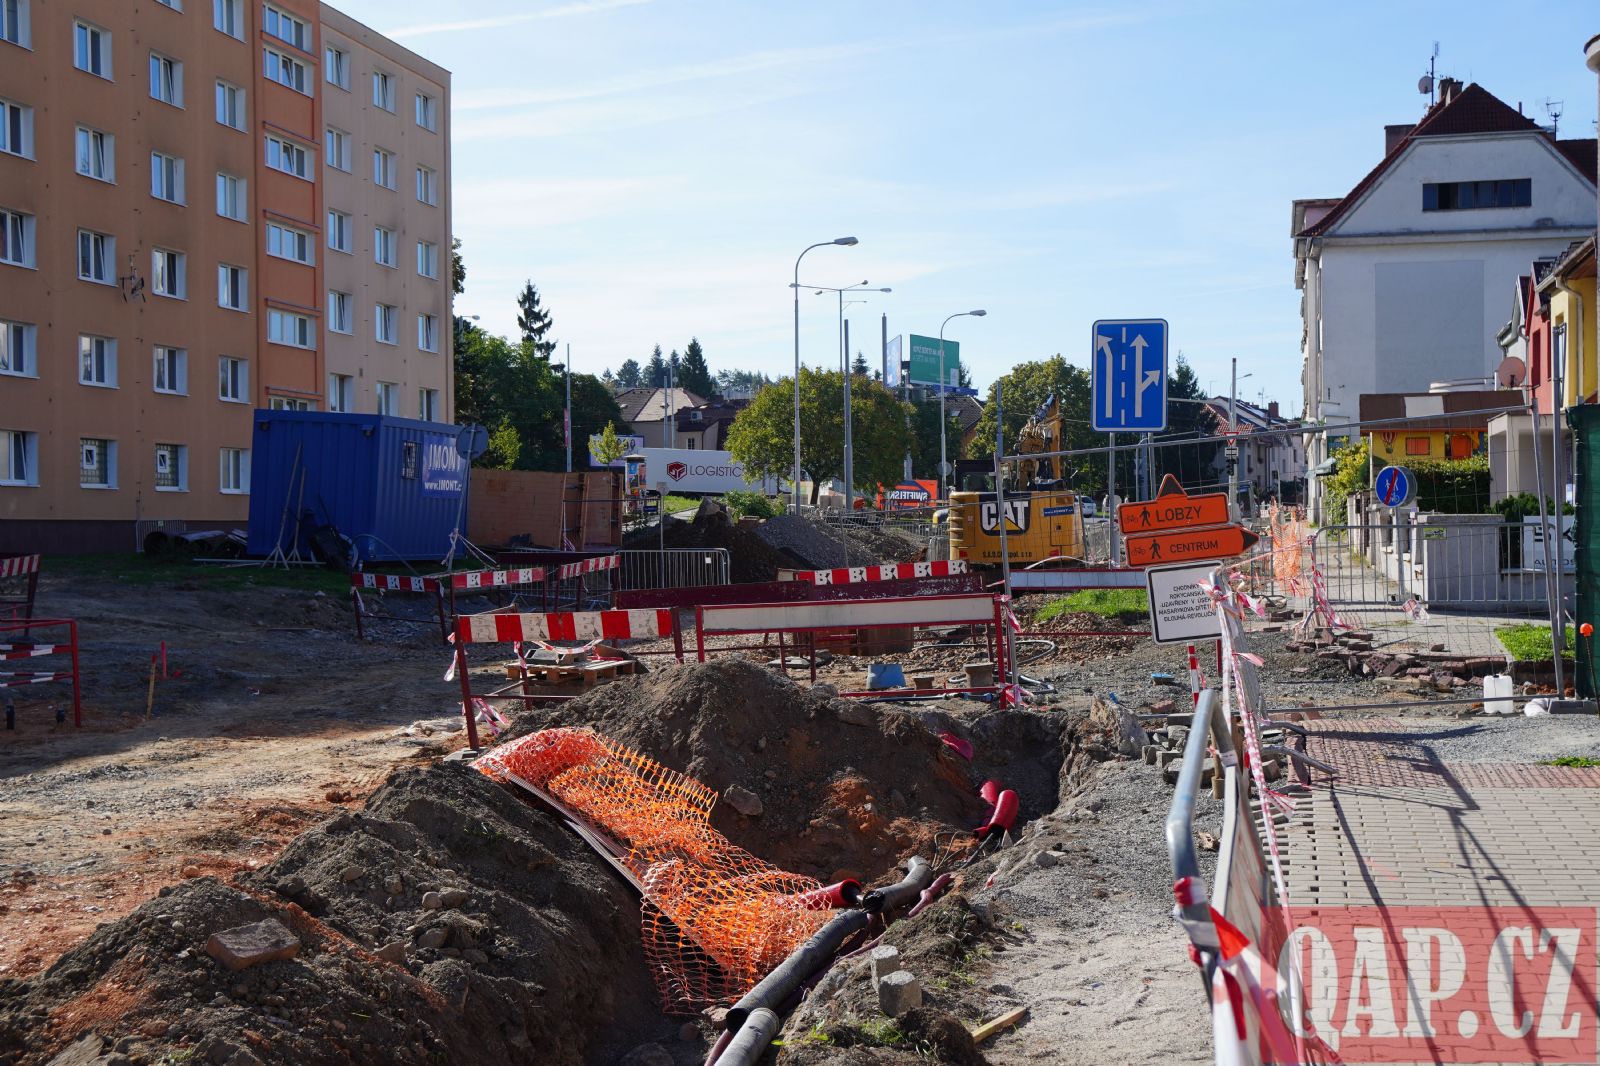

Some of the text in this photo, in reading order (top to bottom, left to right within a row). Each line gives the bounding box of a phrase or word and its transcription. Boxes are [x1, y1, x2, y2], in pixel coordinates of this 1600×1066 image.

[981, 501, 1029, 530] CAT
[1155, 505, 1202, 522] LOBZY
[1169, 540, 1218, 553] CENTRUM
